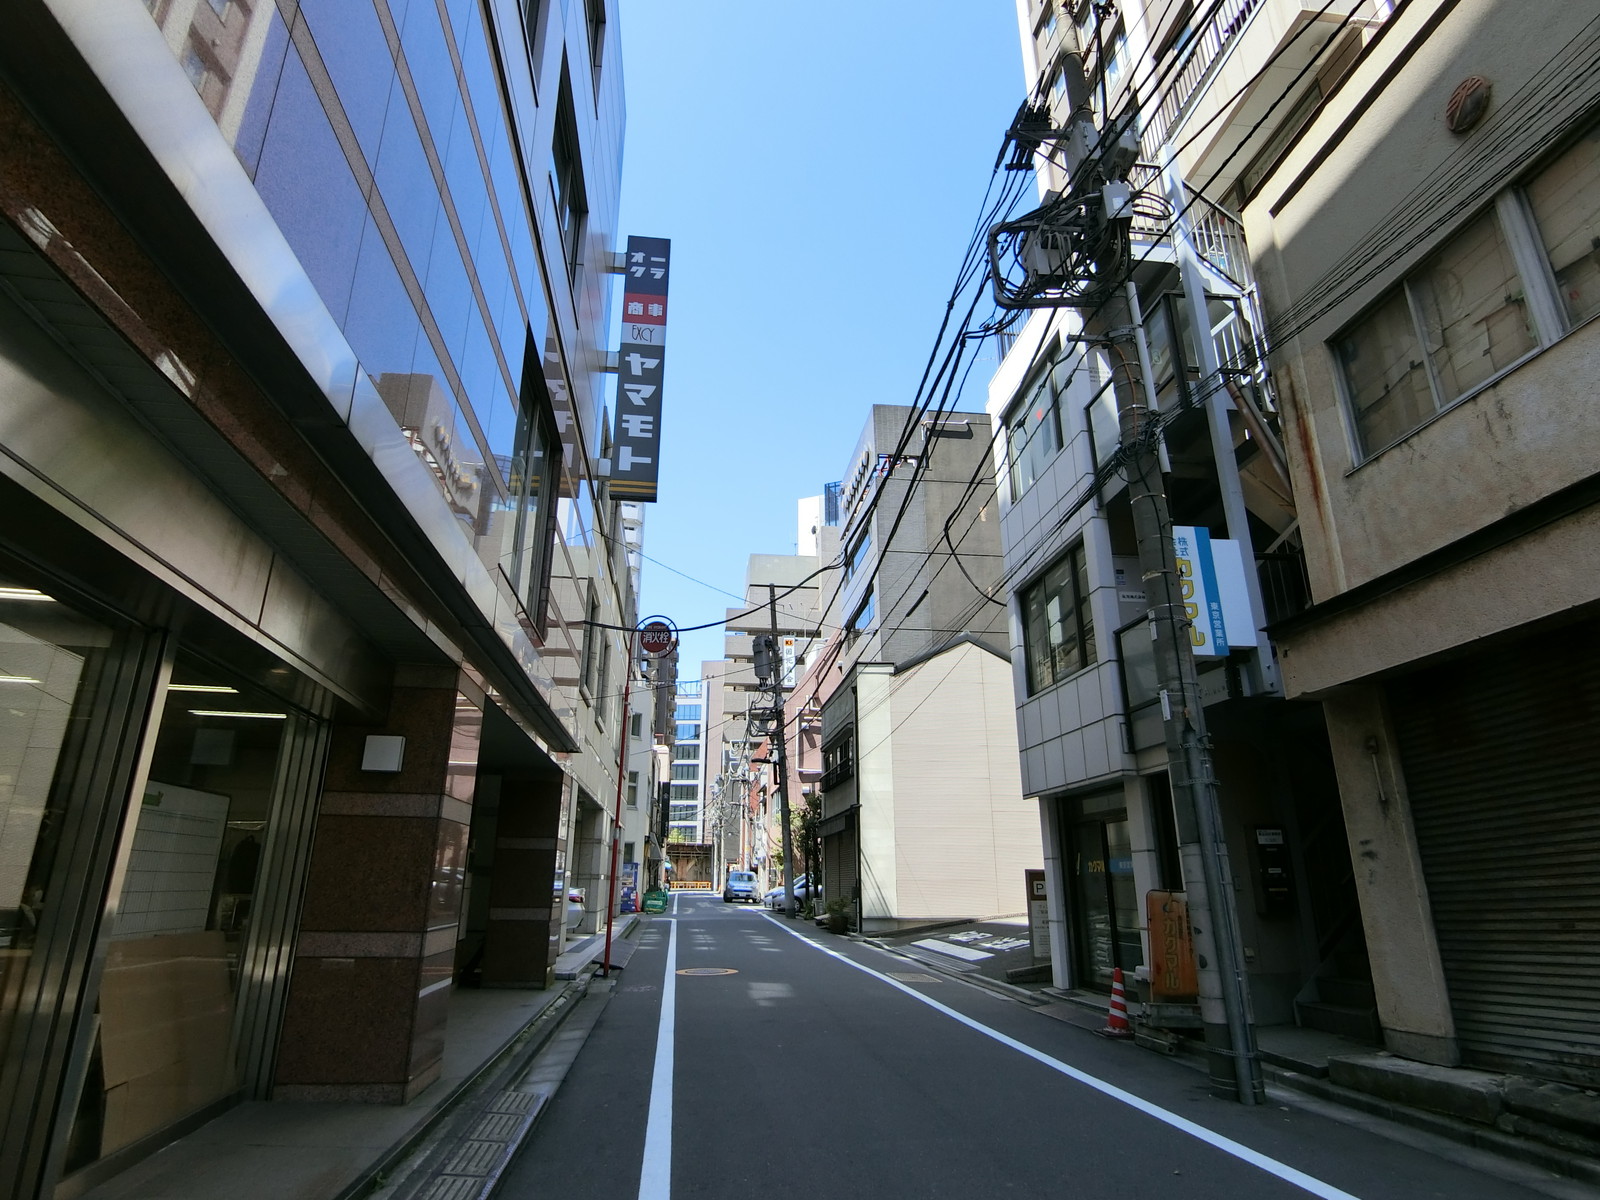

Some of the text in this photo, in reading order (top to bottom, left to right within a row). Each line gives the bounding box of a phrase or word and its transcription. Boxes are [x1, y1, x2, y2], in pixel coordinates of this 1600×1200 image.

[627, 301, 663, 318] 商事
[618, 352, 660, 471] ヤマモト
[1209, 601, 1226, 647] 東京営業所
[642, 631, 670, 645] 消火栓
[1036, 883, 1044, 893] P
